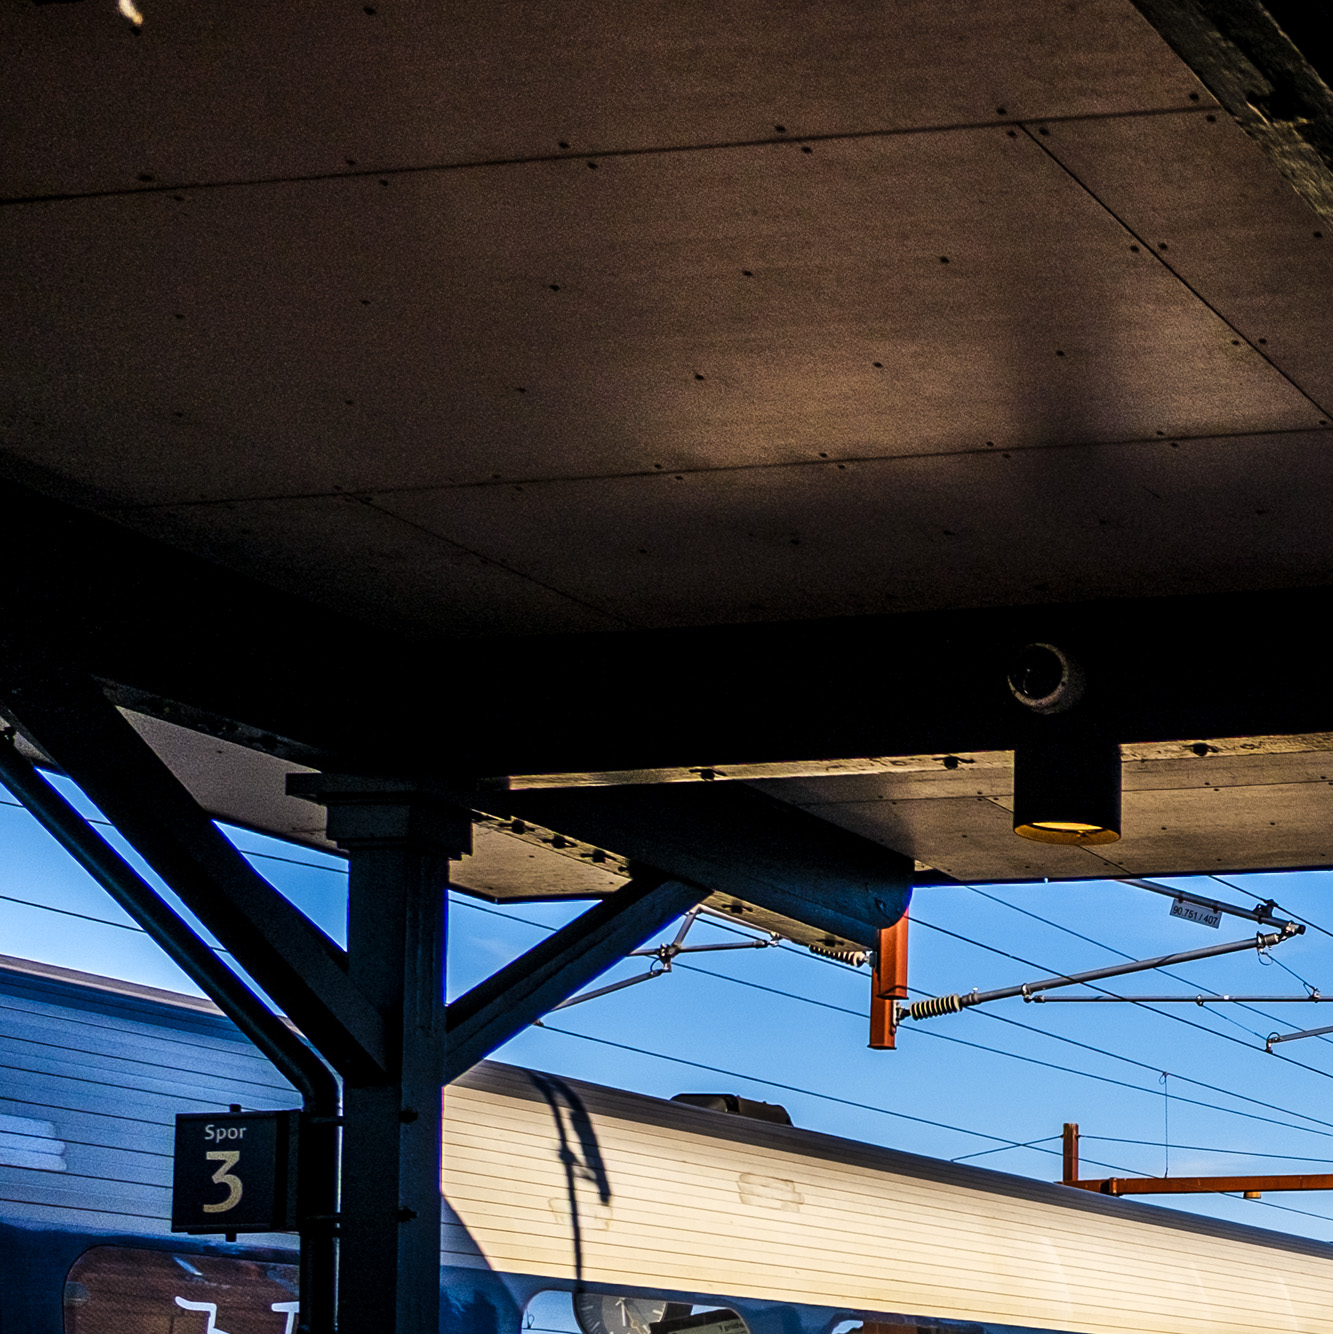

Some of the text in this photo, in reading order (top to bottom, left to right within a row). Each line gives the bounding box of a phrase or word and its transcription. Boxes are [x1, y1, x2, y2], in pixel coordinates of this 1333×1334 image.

[1173, 906, 1197, 919] 90.751
[1204, 915, 1218, 924] 407
[204, 1124, 247, 1143] Spor
[203, 1151, 242, 1212] 3
